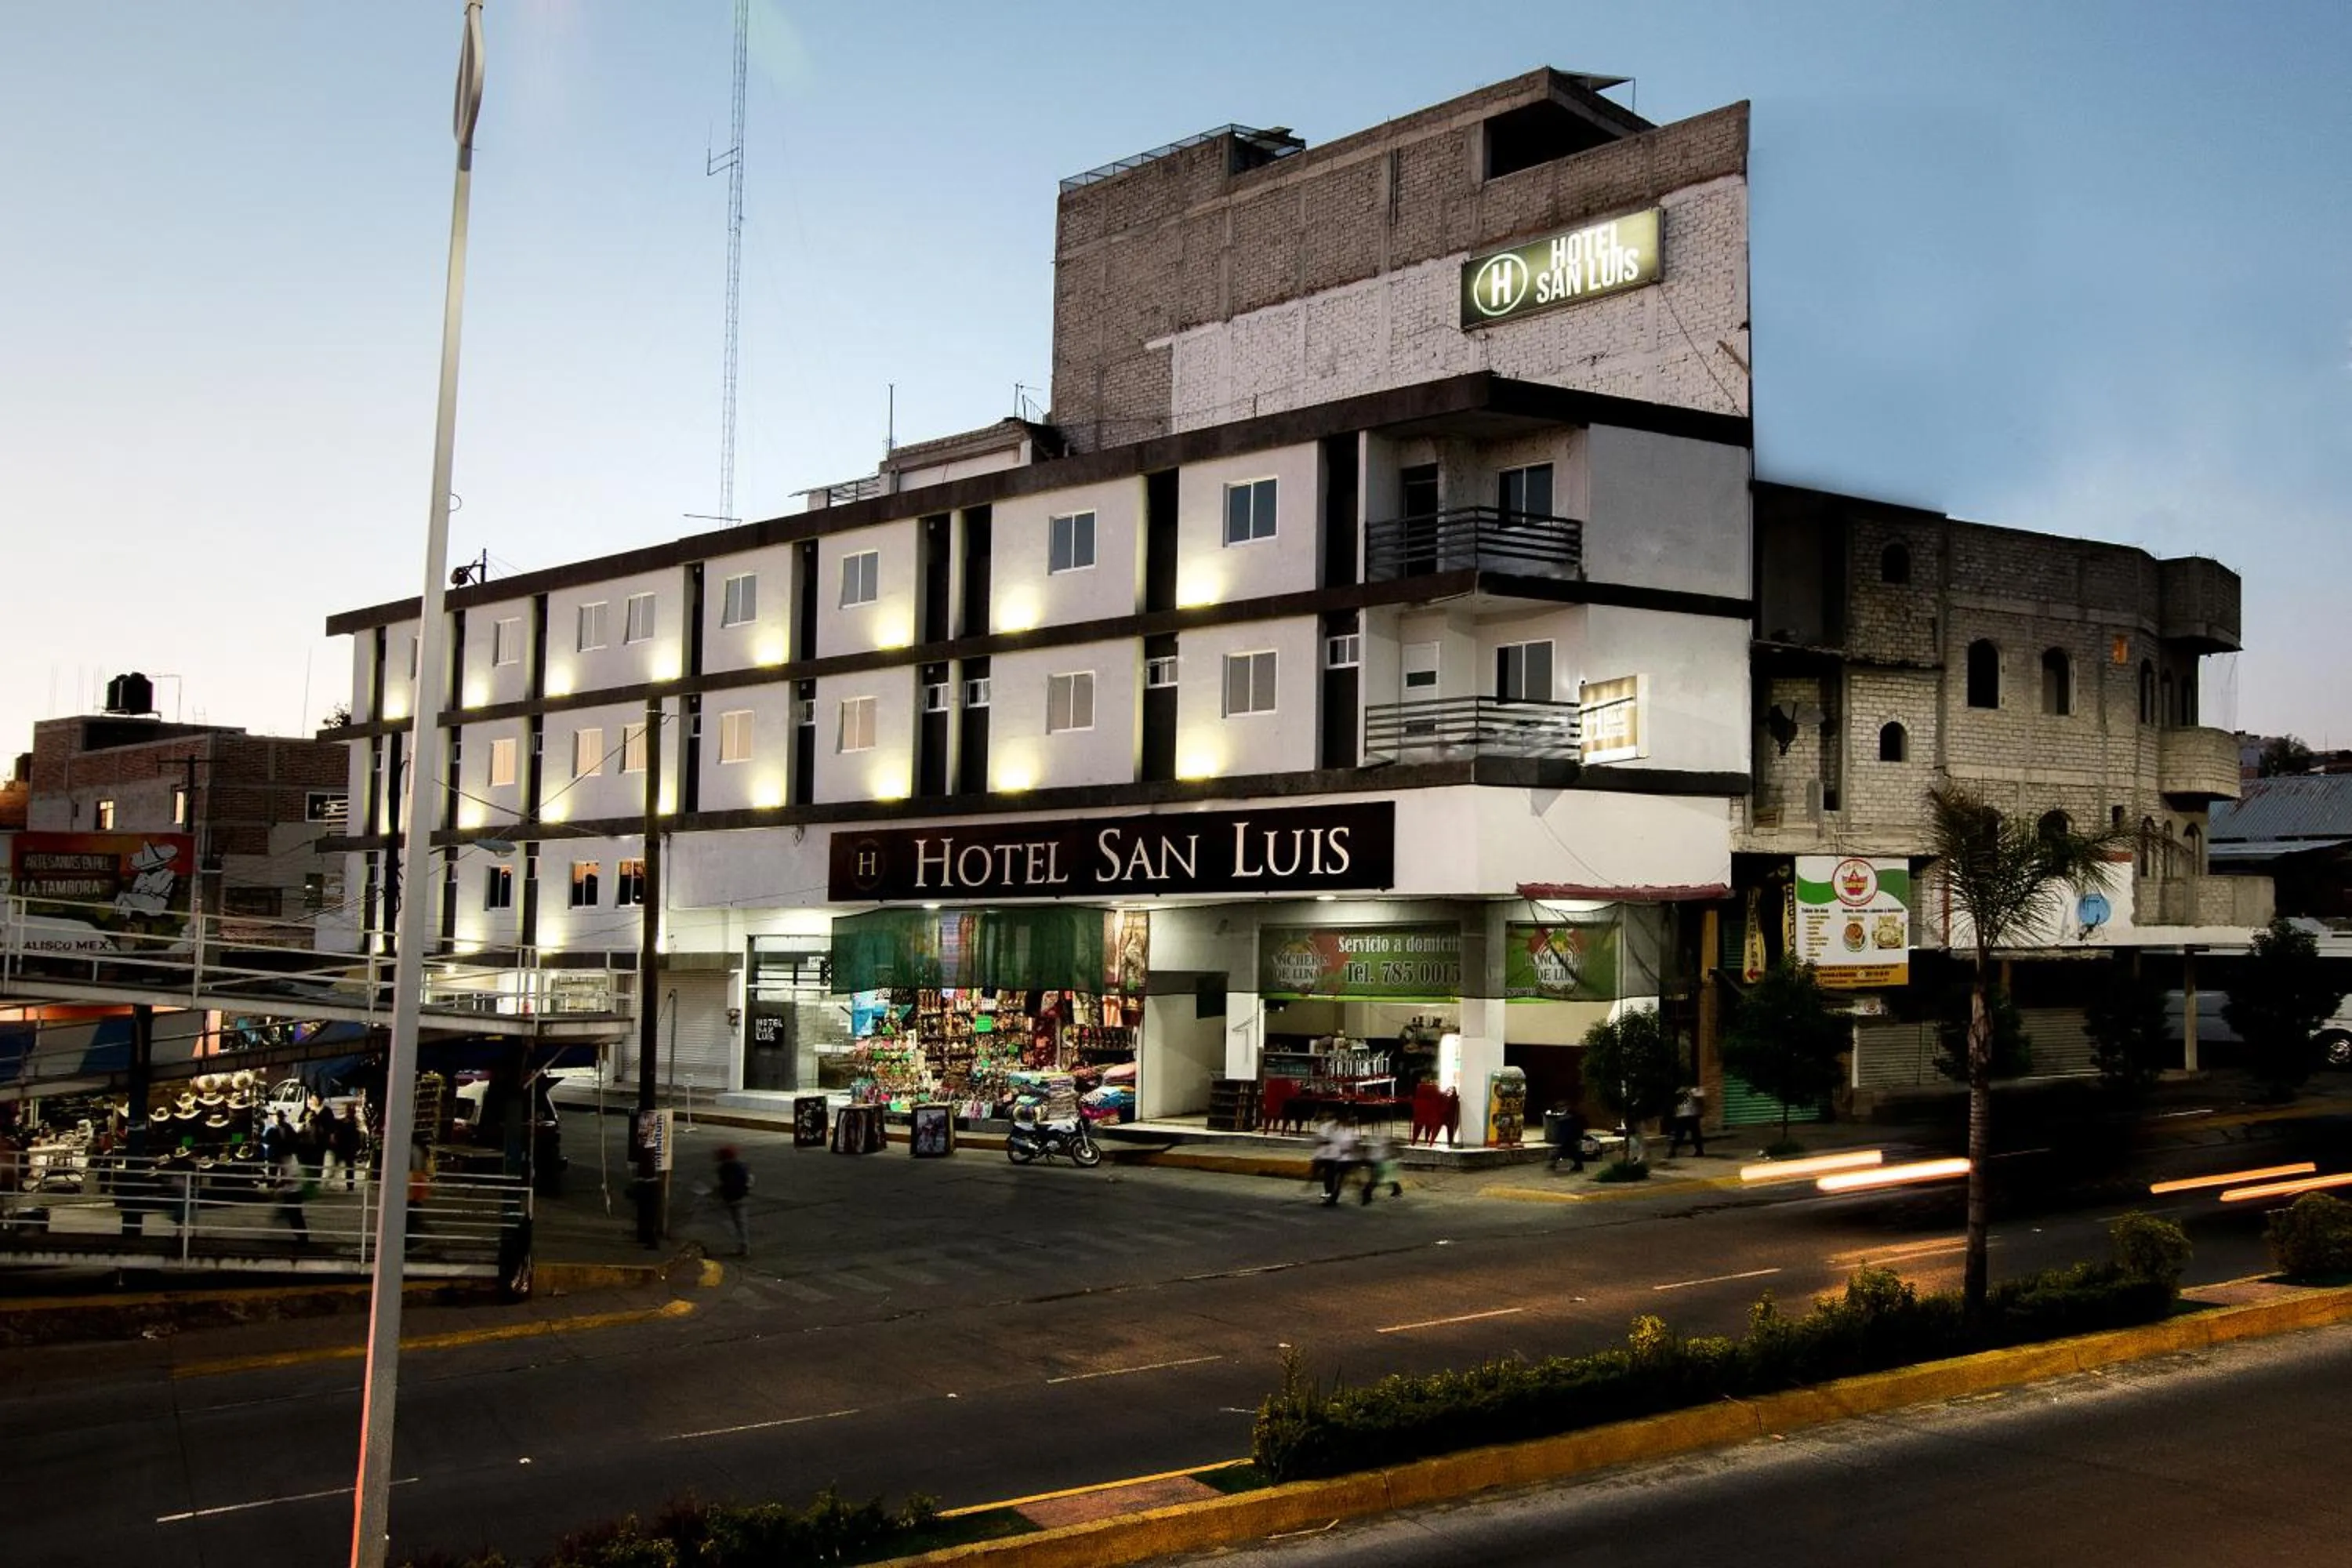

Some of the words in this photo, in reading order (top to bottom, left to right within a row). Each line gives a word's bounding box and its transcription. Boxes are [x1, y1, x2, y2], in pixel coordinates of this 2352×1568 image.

[1551, 221, 1618, 270] HOTEL
[1536, 261, 1582, 304] SAN
[1587, 245, 1640, 292] LUIS
[914, 837, 1069, 887] HOTEL
[1095, 828, 1200, 882] SAN
[1231, 821, 1351, 878] LUIS
[21, 940, 71, 951] ALISCO
[1338, 935, 1390, 953] Servicio
[1393, 939, 1401, 953] a
[1345, 961, 1374, 982] Tel.
[1382, 961, 1414, 984] 785
